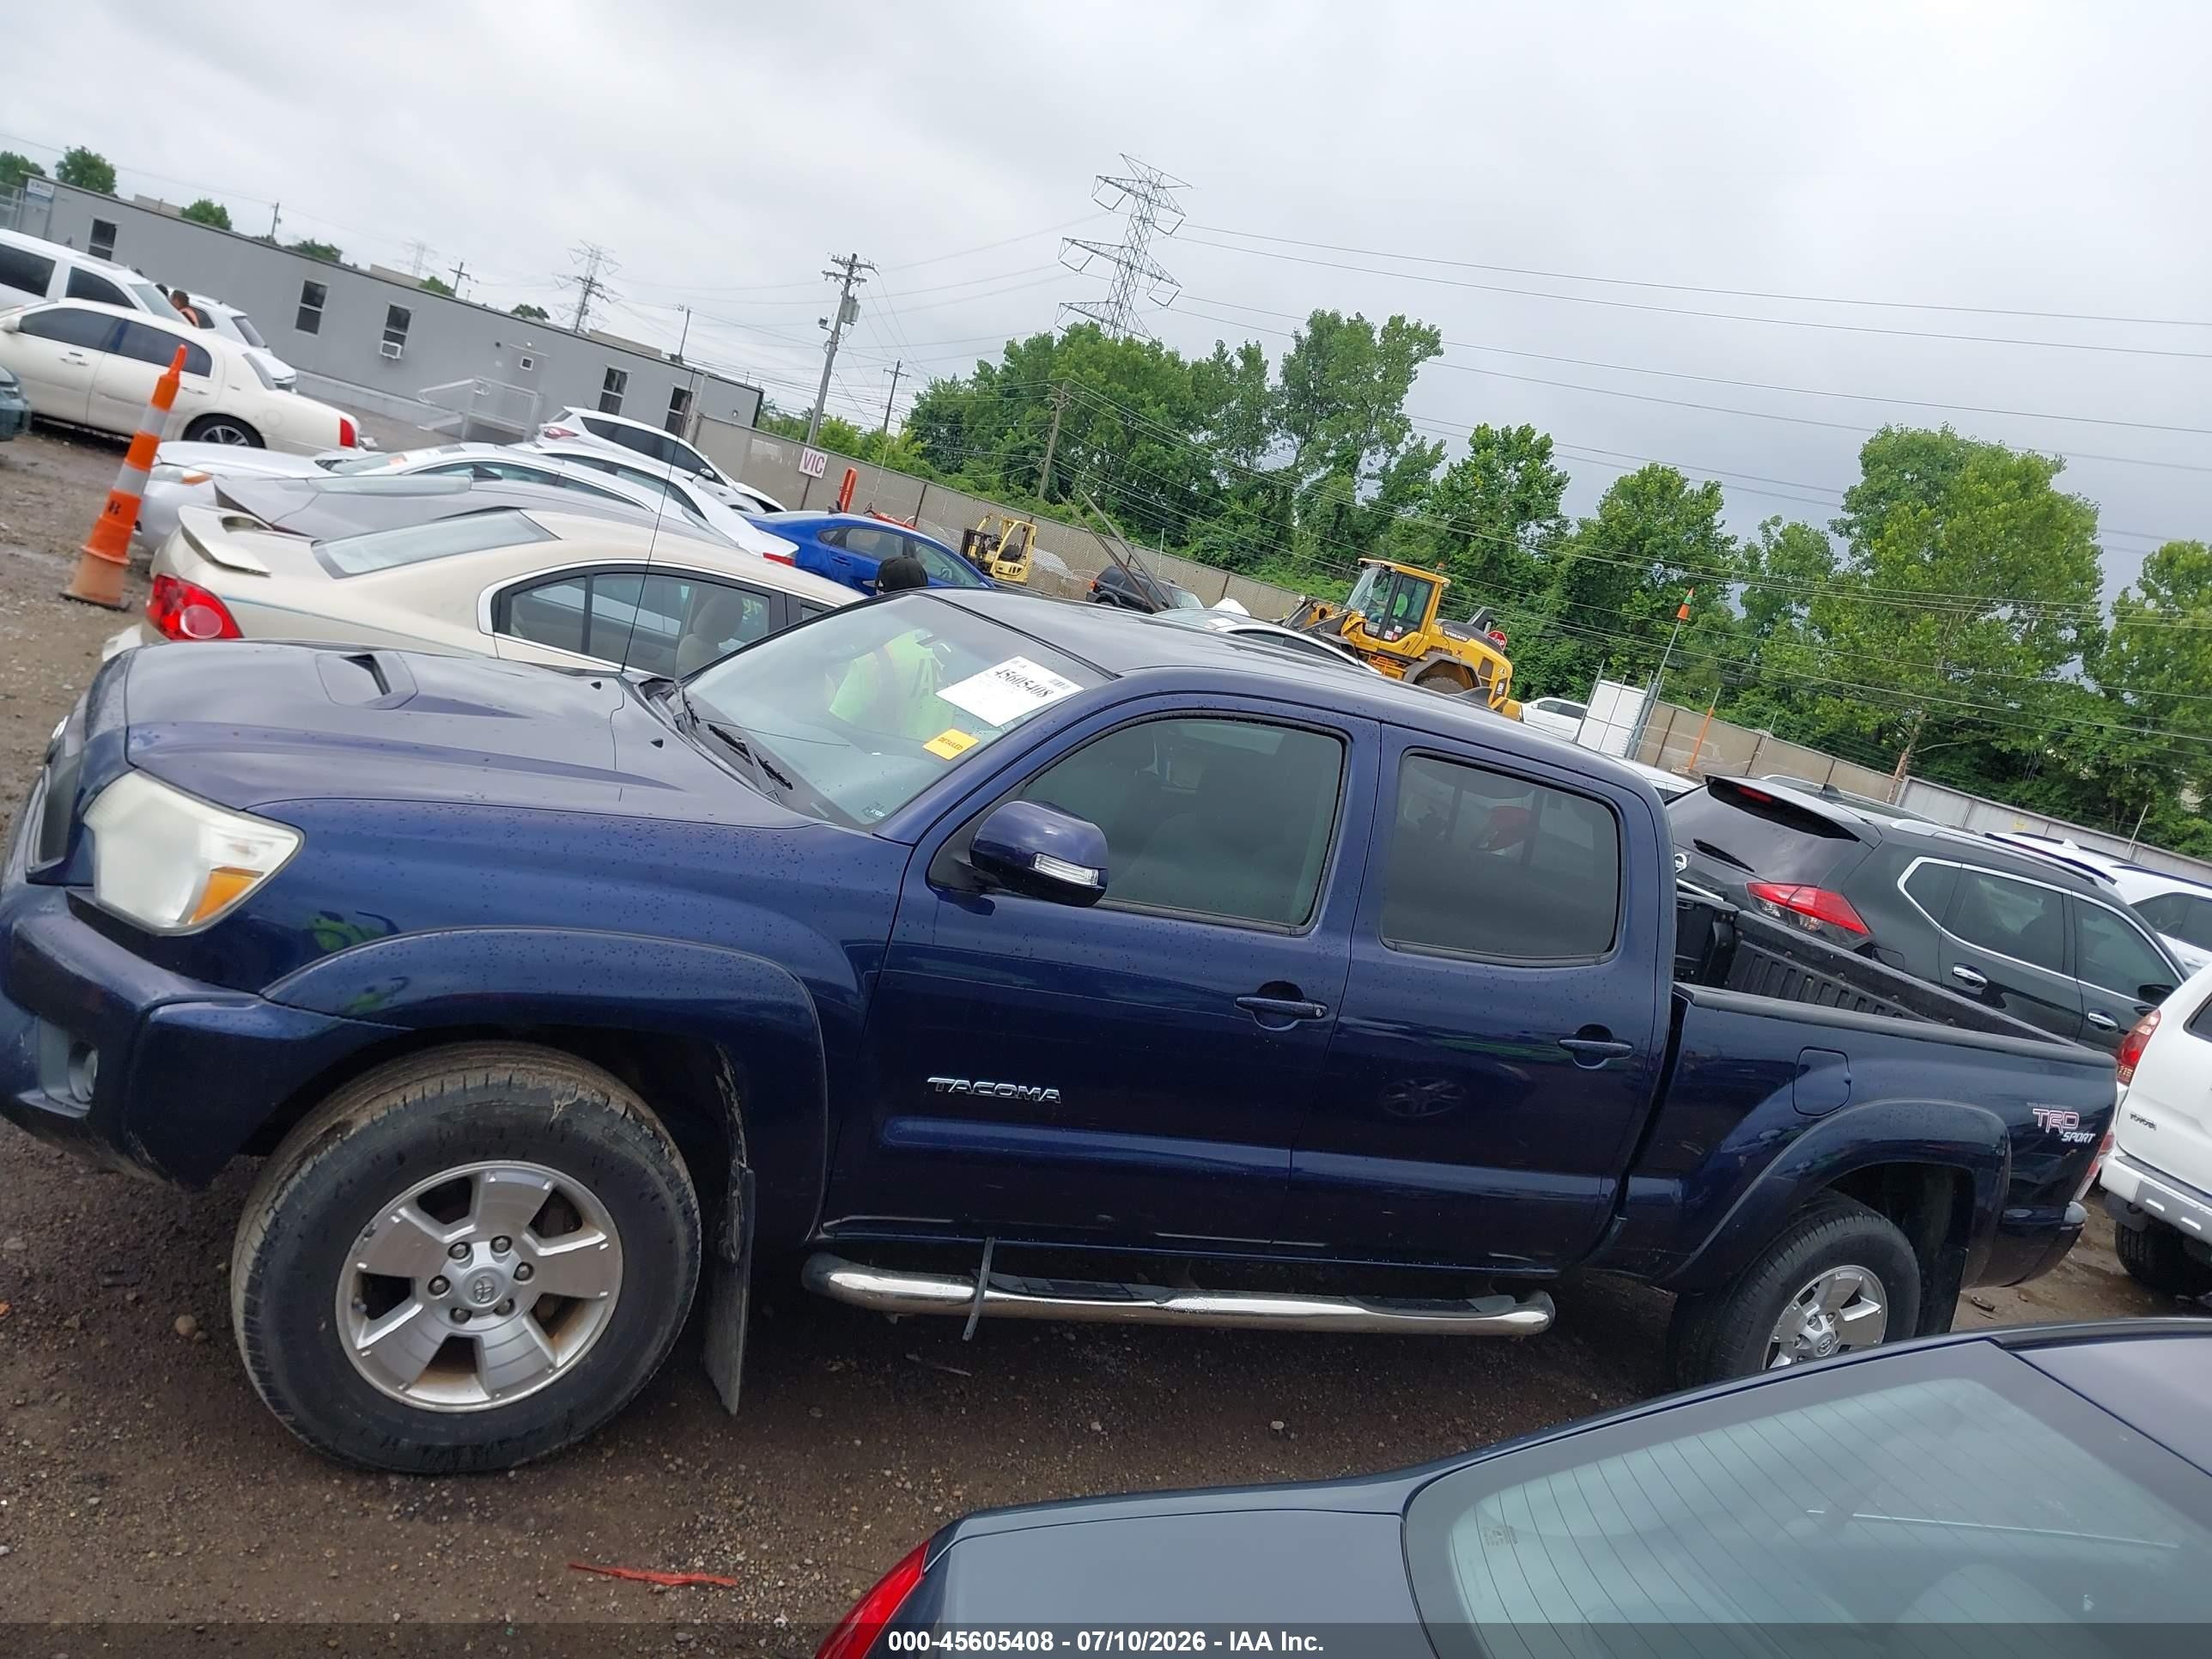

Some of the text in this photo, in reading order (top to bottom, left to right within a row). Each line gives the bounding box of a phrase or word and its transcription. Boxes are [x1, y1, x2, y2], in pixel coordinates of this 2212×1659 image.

[803, 451, 825, 475] VIC
[1444, 629, 1468, 641] VOLVO
[994, 668, 1054, 698] 45605408
[937, 736, 963, 751] DETAILED
[927, 1077, 1061, 1104] TACOMA
[2032, 1108, 2080, 1134] TRD
[2061, 1131, 2097, 1144] SPORT
